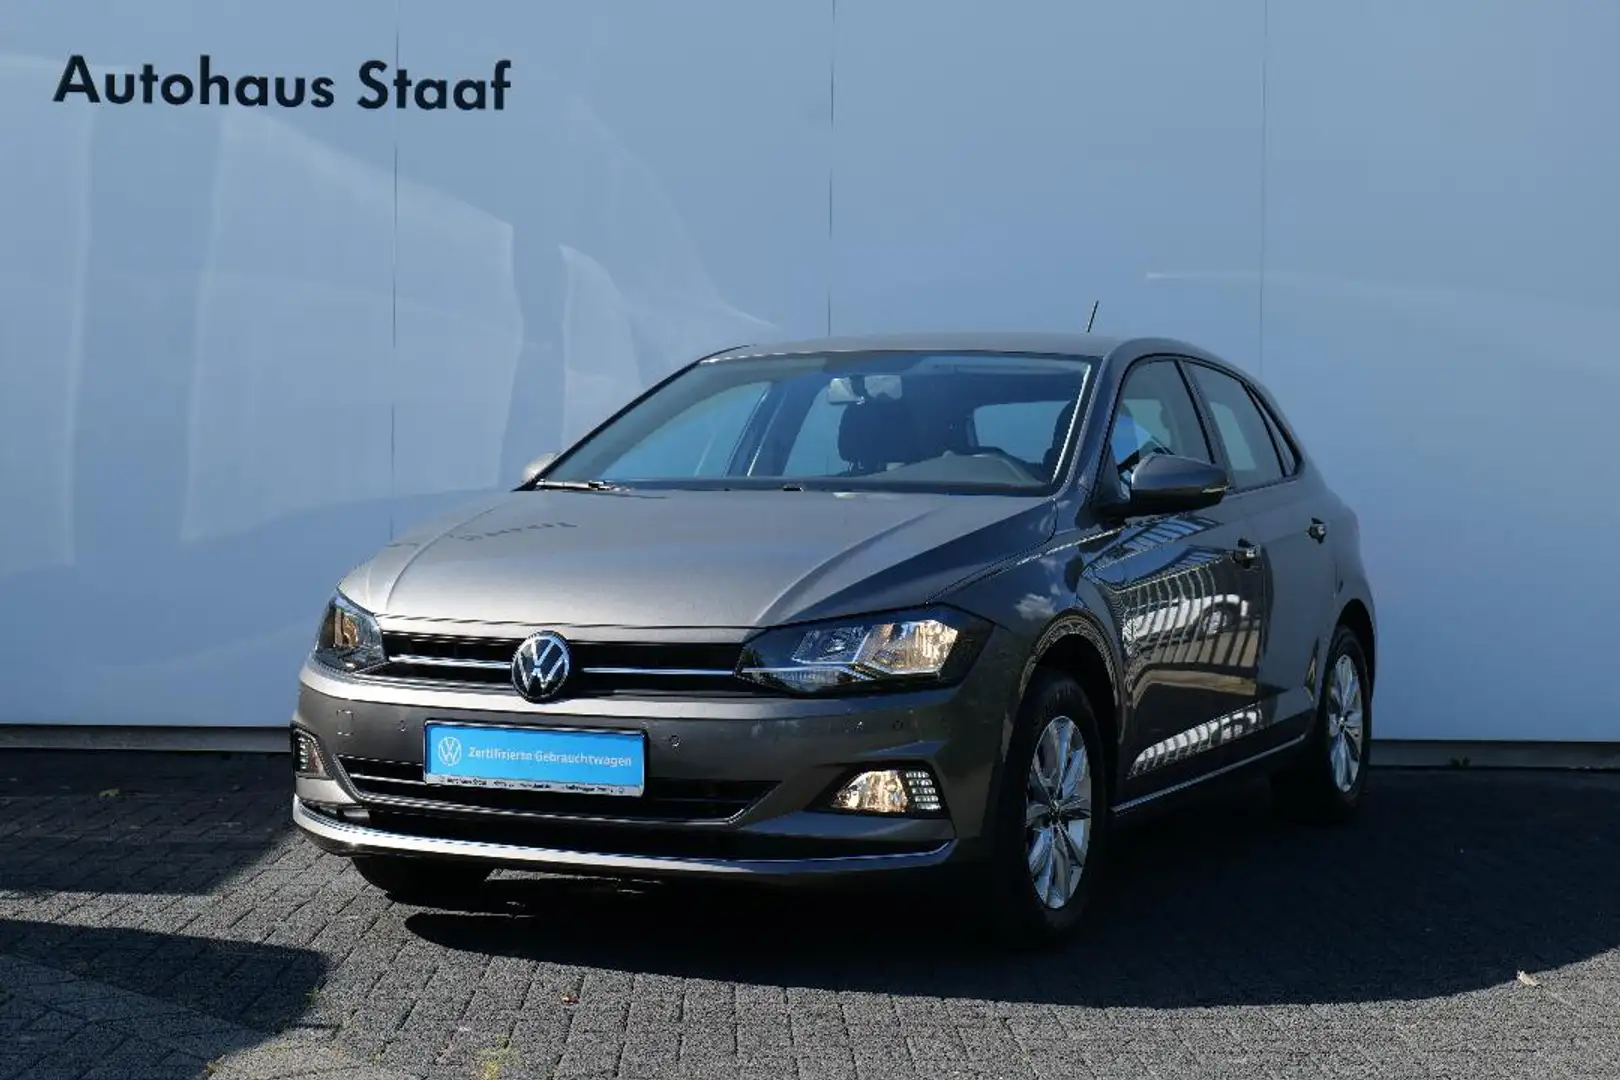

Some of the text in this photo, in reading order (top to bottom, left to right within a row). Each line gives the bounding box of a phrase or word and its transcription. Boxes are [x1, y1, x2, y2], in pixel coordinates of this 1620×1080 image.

[53, 54, 512, 111] Autohaus Staaf
[534, 750, 632, 768] Gebrauchtwagen
